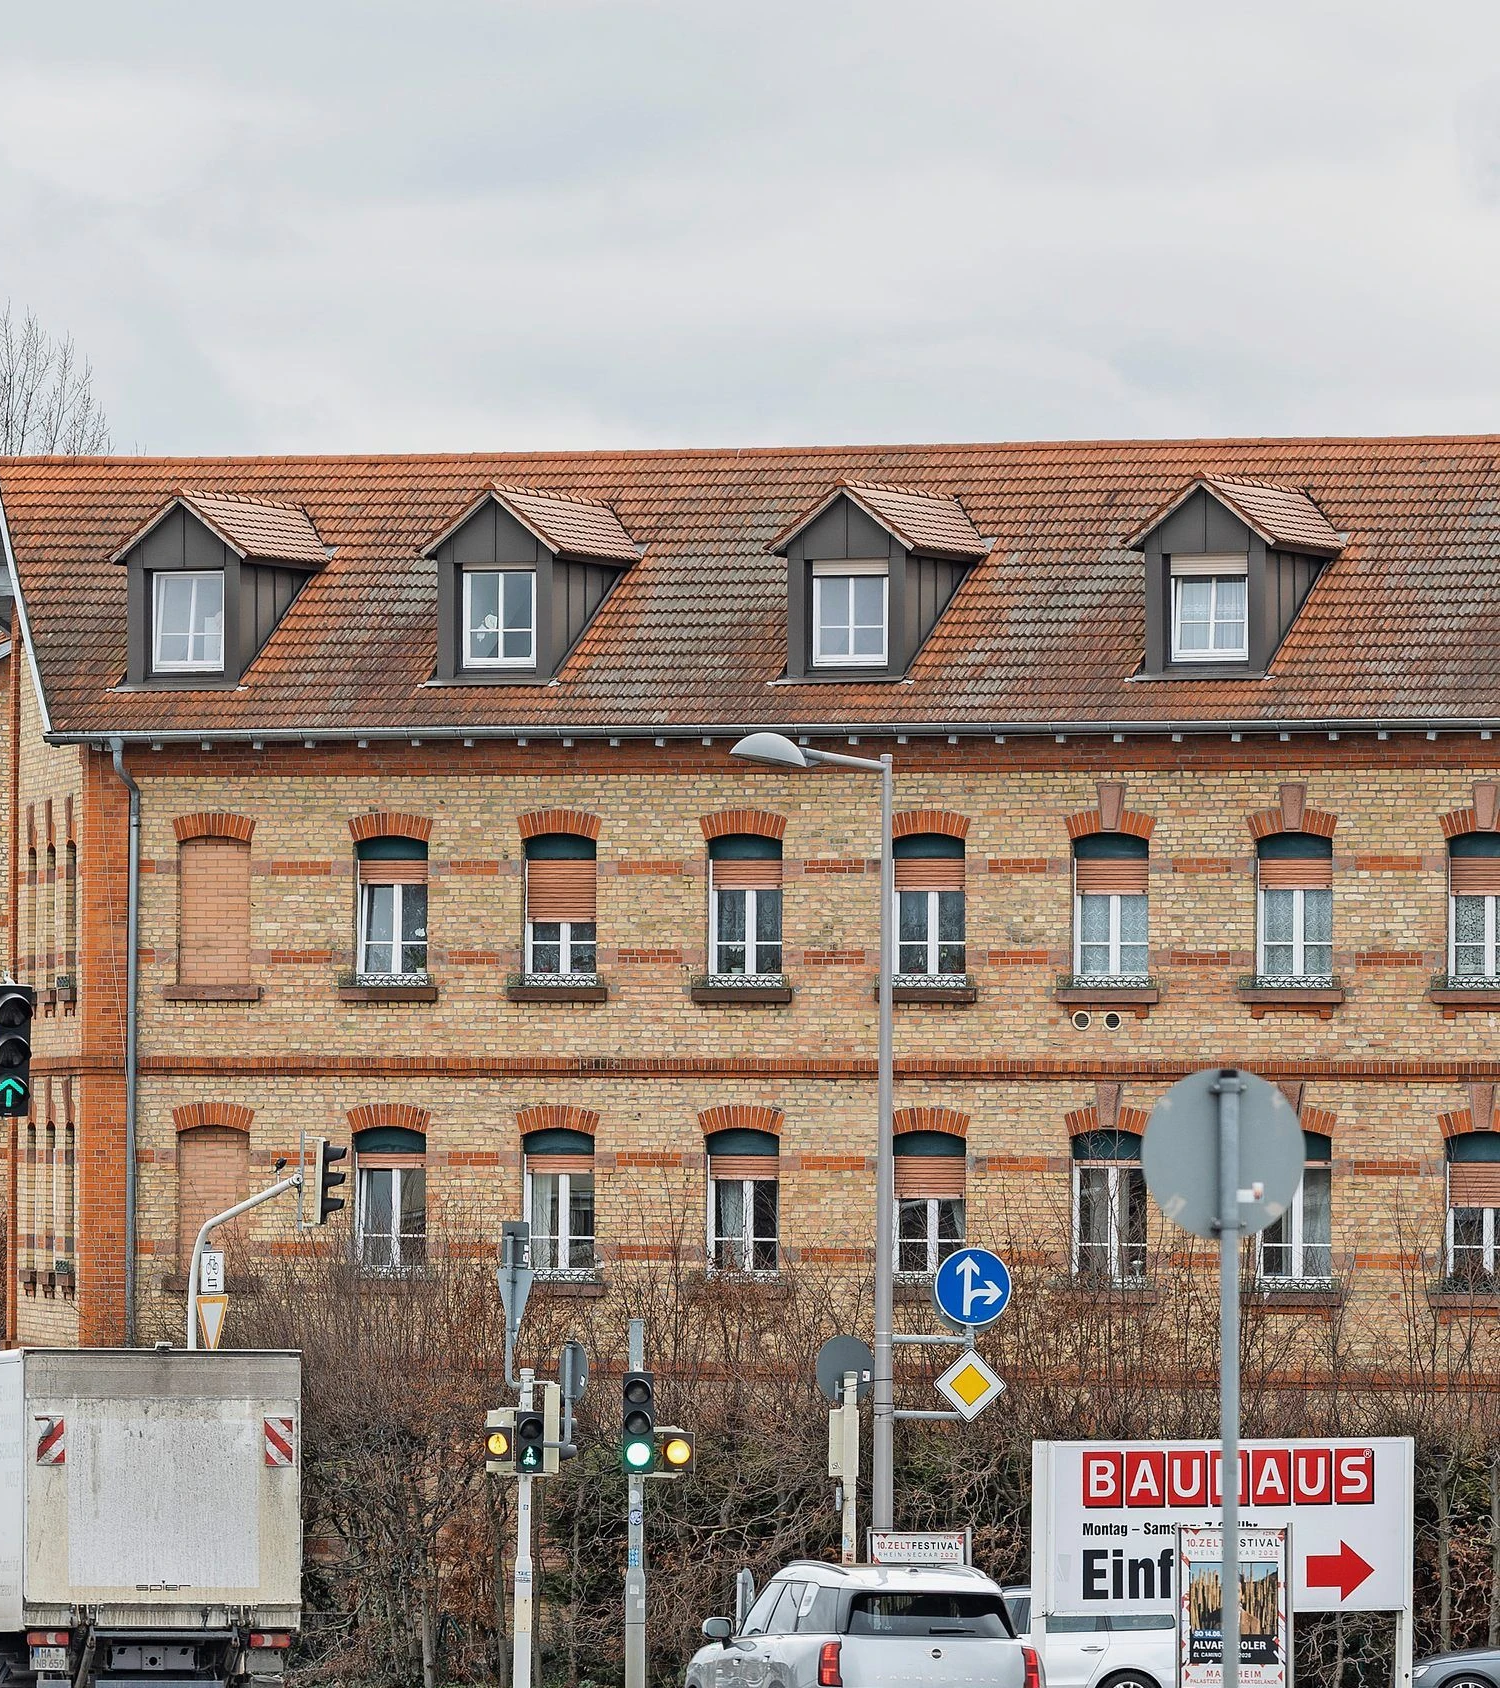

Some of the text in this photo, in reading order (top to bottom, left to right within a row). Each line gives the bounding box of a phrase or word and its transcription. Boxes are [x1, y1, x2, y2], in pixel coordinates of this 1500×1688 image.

[1082, 1522, 1128, 1537] Montag
[1187, 1538, 1280, 1548] 10.ZELTSTIVAL
[136, 1580, 191, 1593] spier
[1193, 1641, 1224, 1650] ALVAR
[41, 1649, 51, 1658] MA
[36, 1658, 64, 1668] NB 659
[1206, 1670, 1262, 1678] MAHEIM
